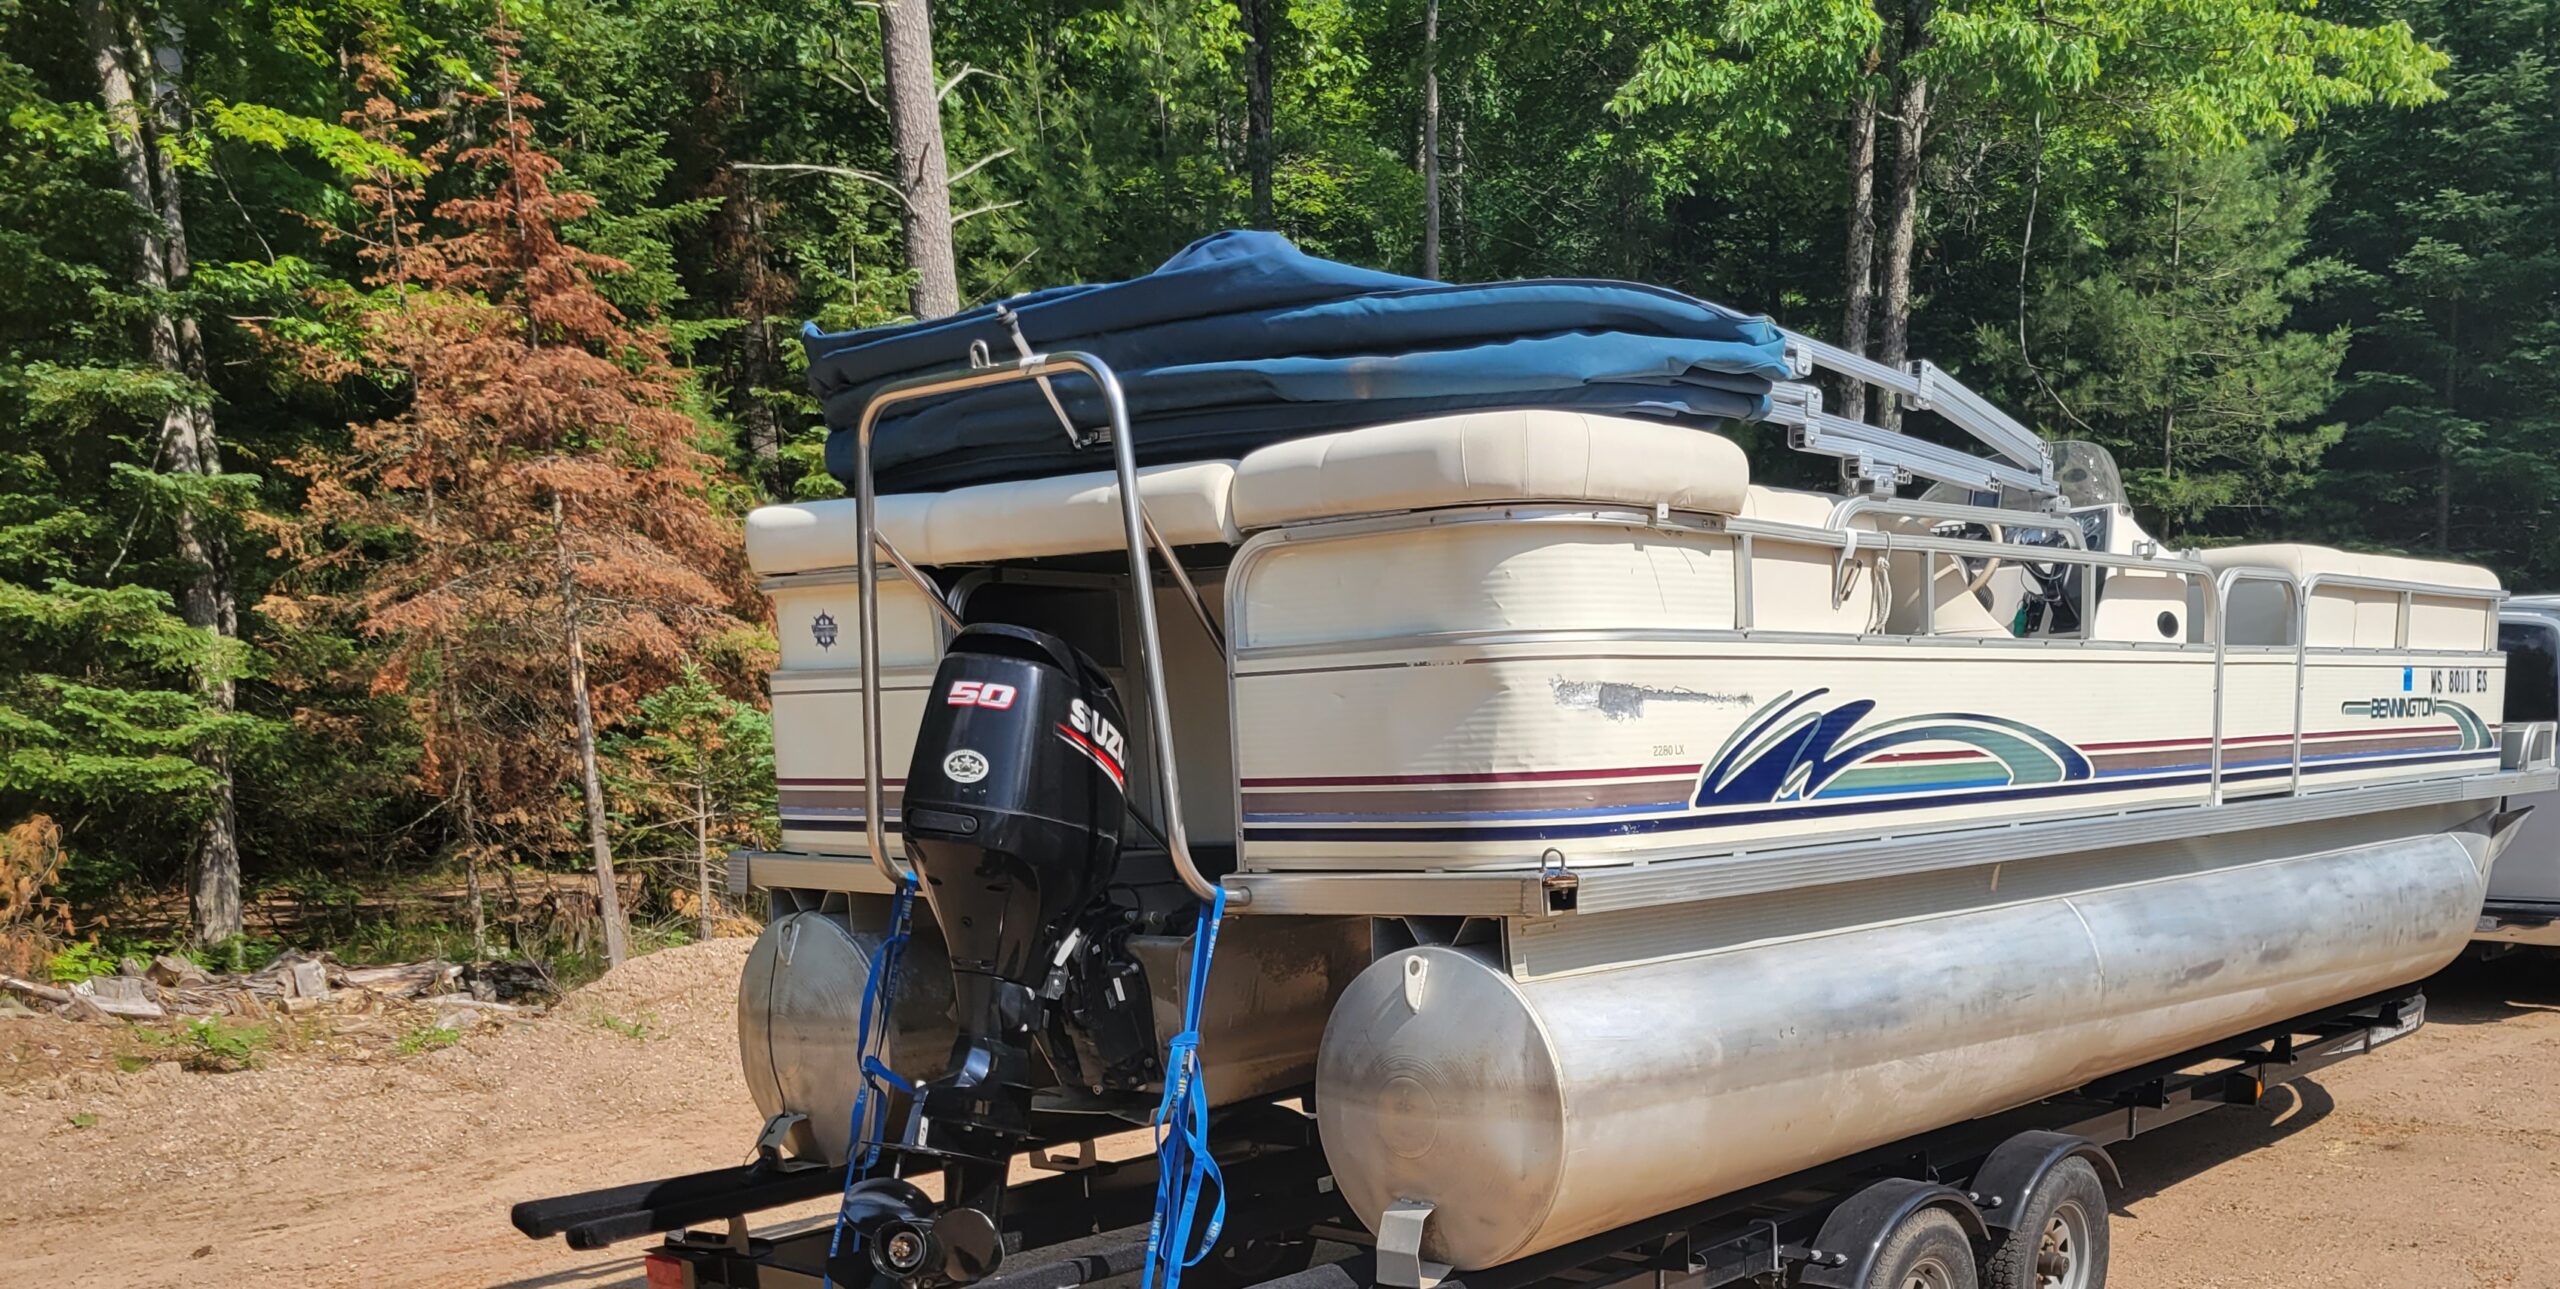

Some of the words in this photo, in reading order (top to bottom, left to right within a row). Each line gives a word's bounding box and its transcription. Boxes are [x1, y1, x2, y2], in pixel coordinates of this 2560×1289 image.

[2449, 669, 2470, 693] 8011
[2477, 669, 2488, 693] ES
[948, 681, 1016, 710] 50
[2371, 697, 2437, 719] BENNINGTON
[1653, 745, 1674, 757] 2280
[1675, 744, 1685, 755] LX
